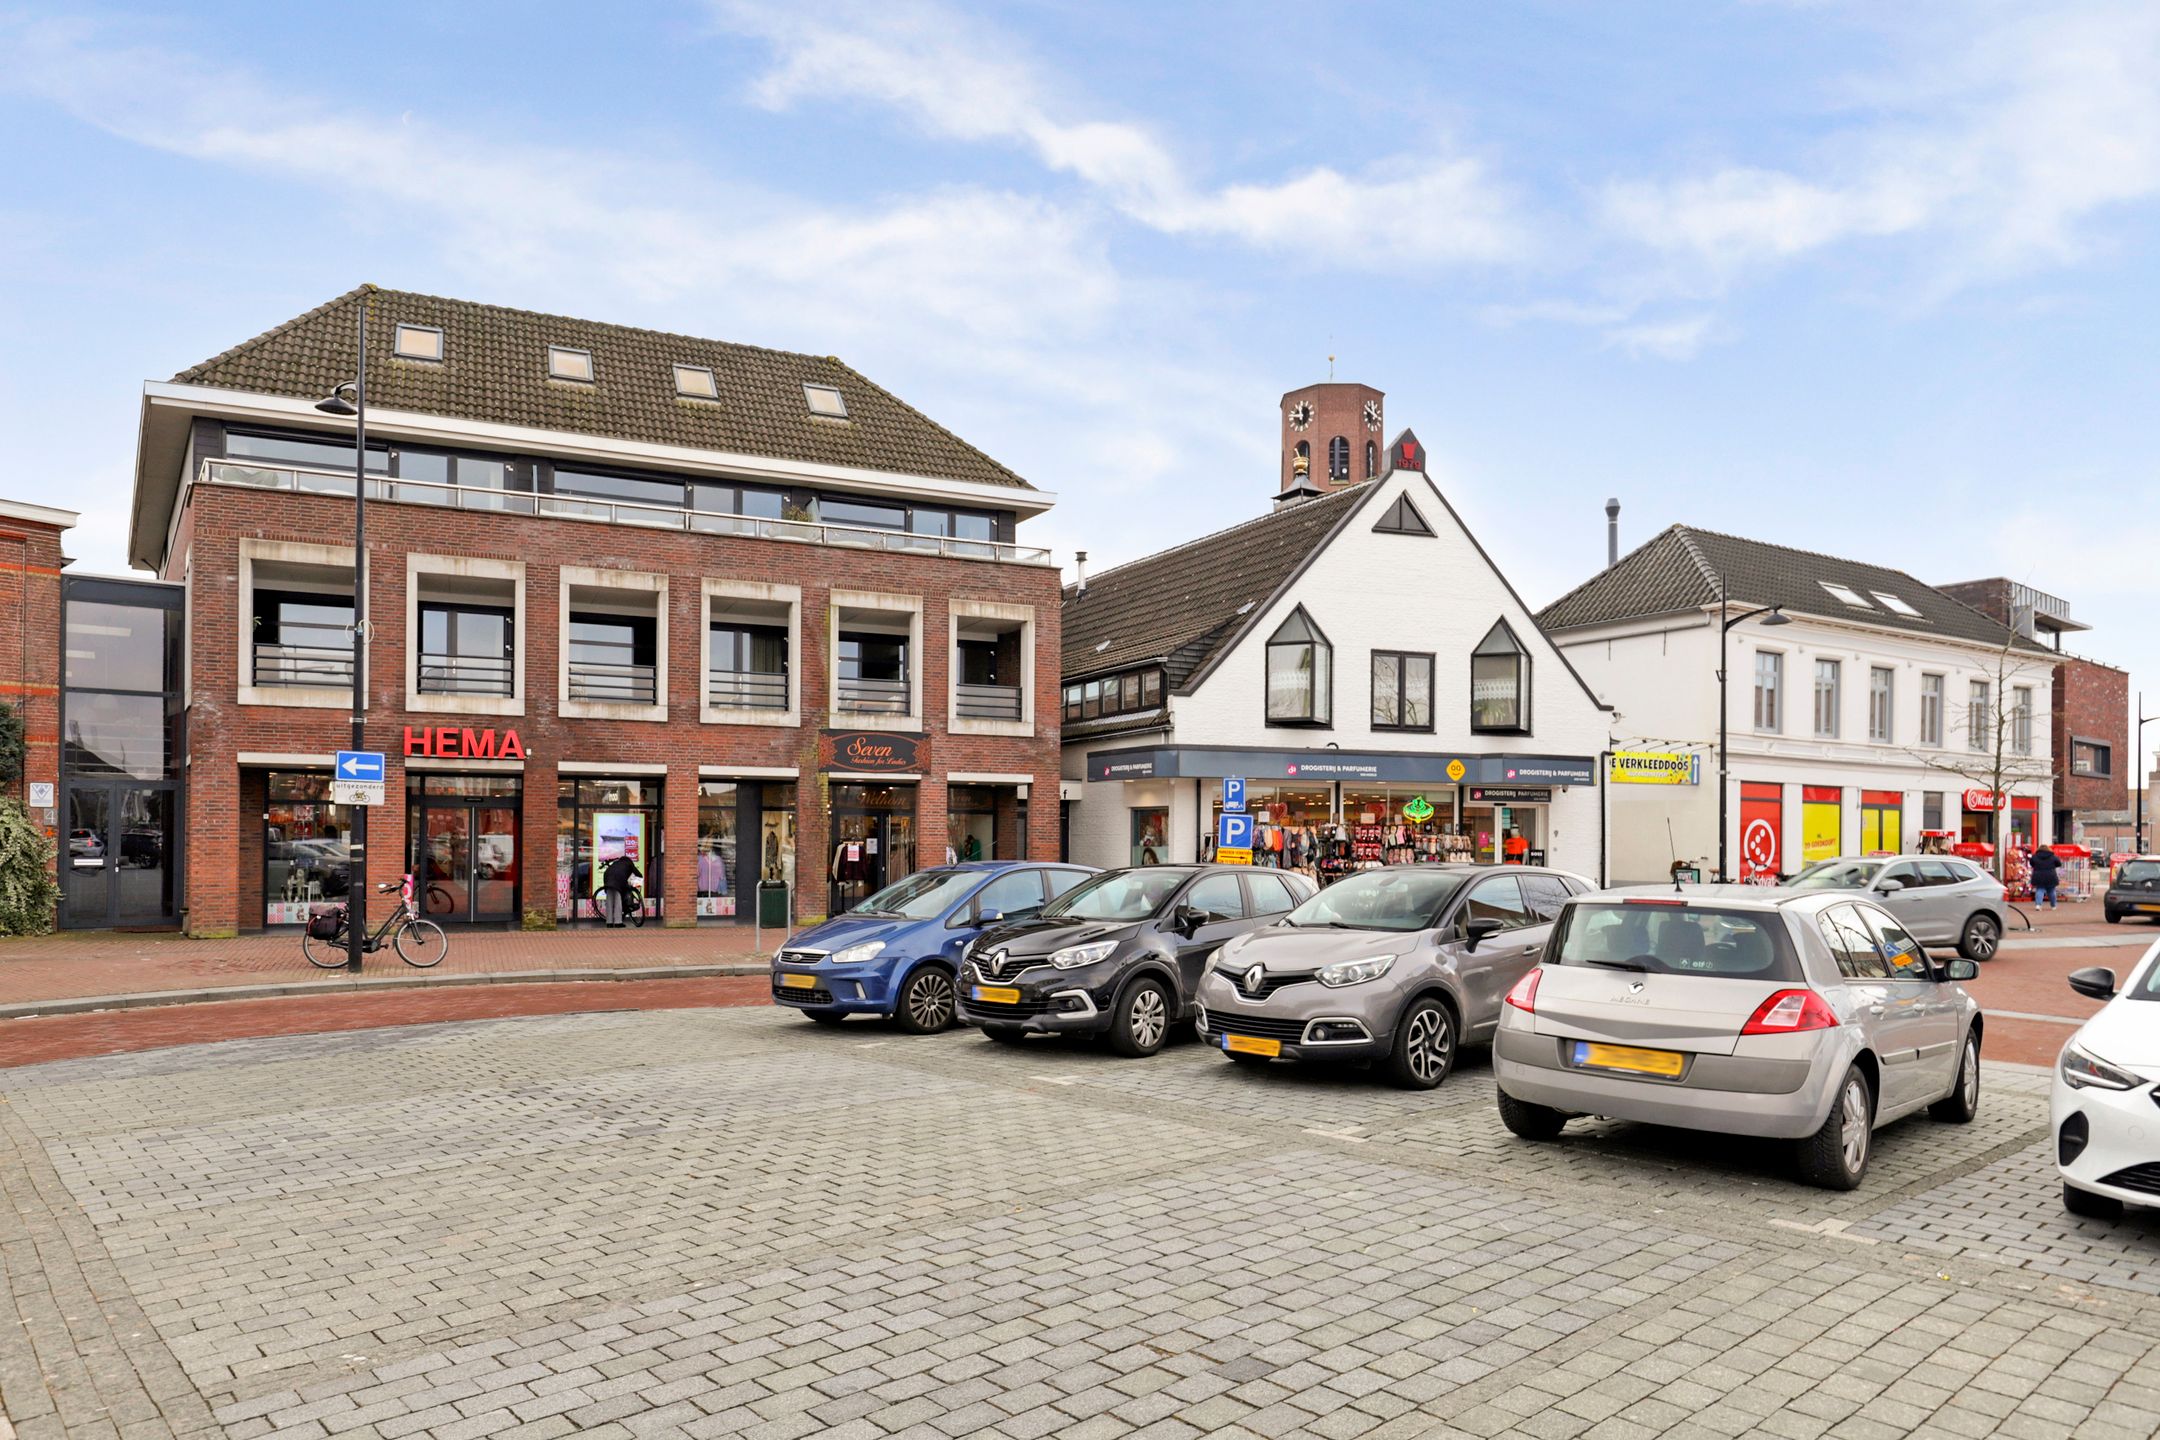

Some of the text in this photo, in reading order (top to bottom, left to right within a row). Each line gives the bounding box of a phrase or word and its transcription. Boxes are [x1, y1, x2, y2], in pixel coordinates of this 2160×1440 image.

[403, 726, 525, 759] HEMA
[847, 737, 892, 757] Seven
[1619, 758, 1689, 771] VERKLEEDDOOS
[1228, 781, 1241, 798] P
[45, 811, 56, 823] 4
[1226, 818, 1246, 845] P
